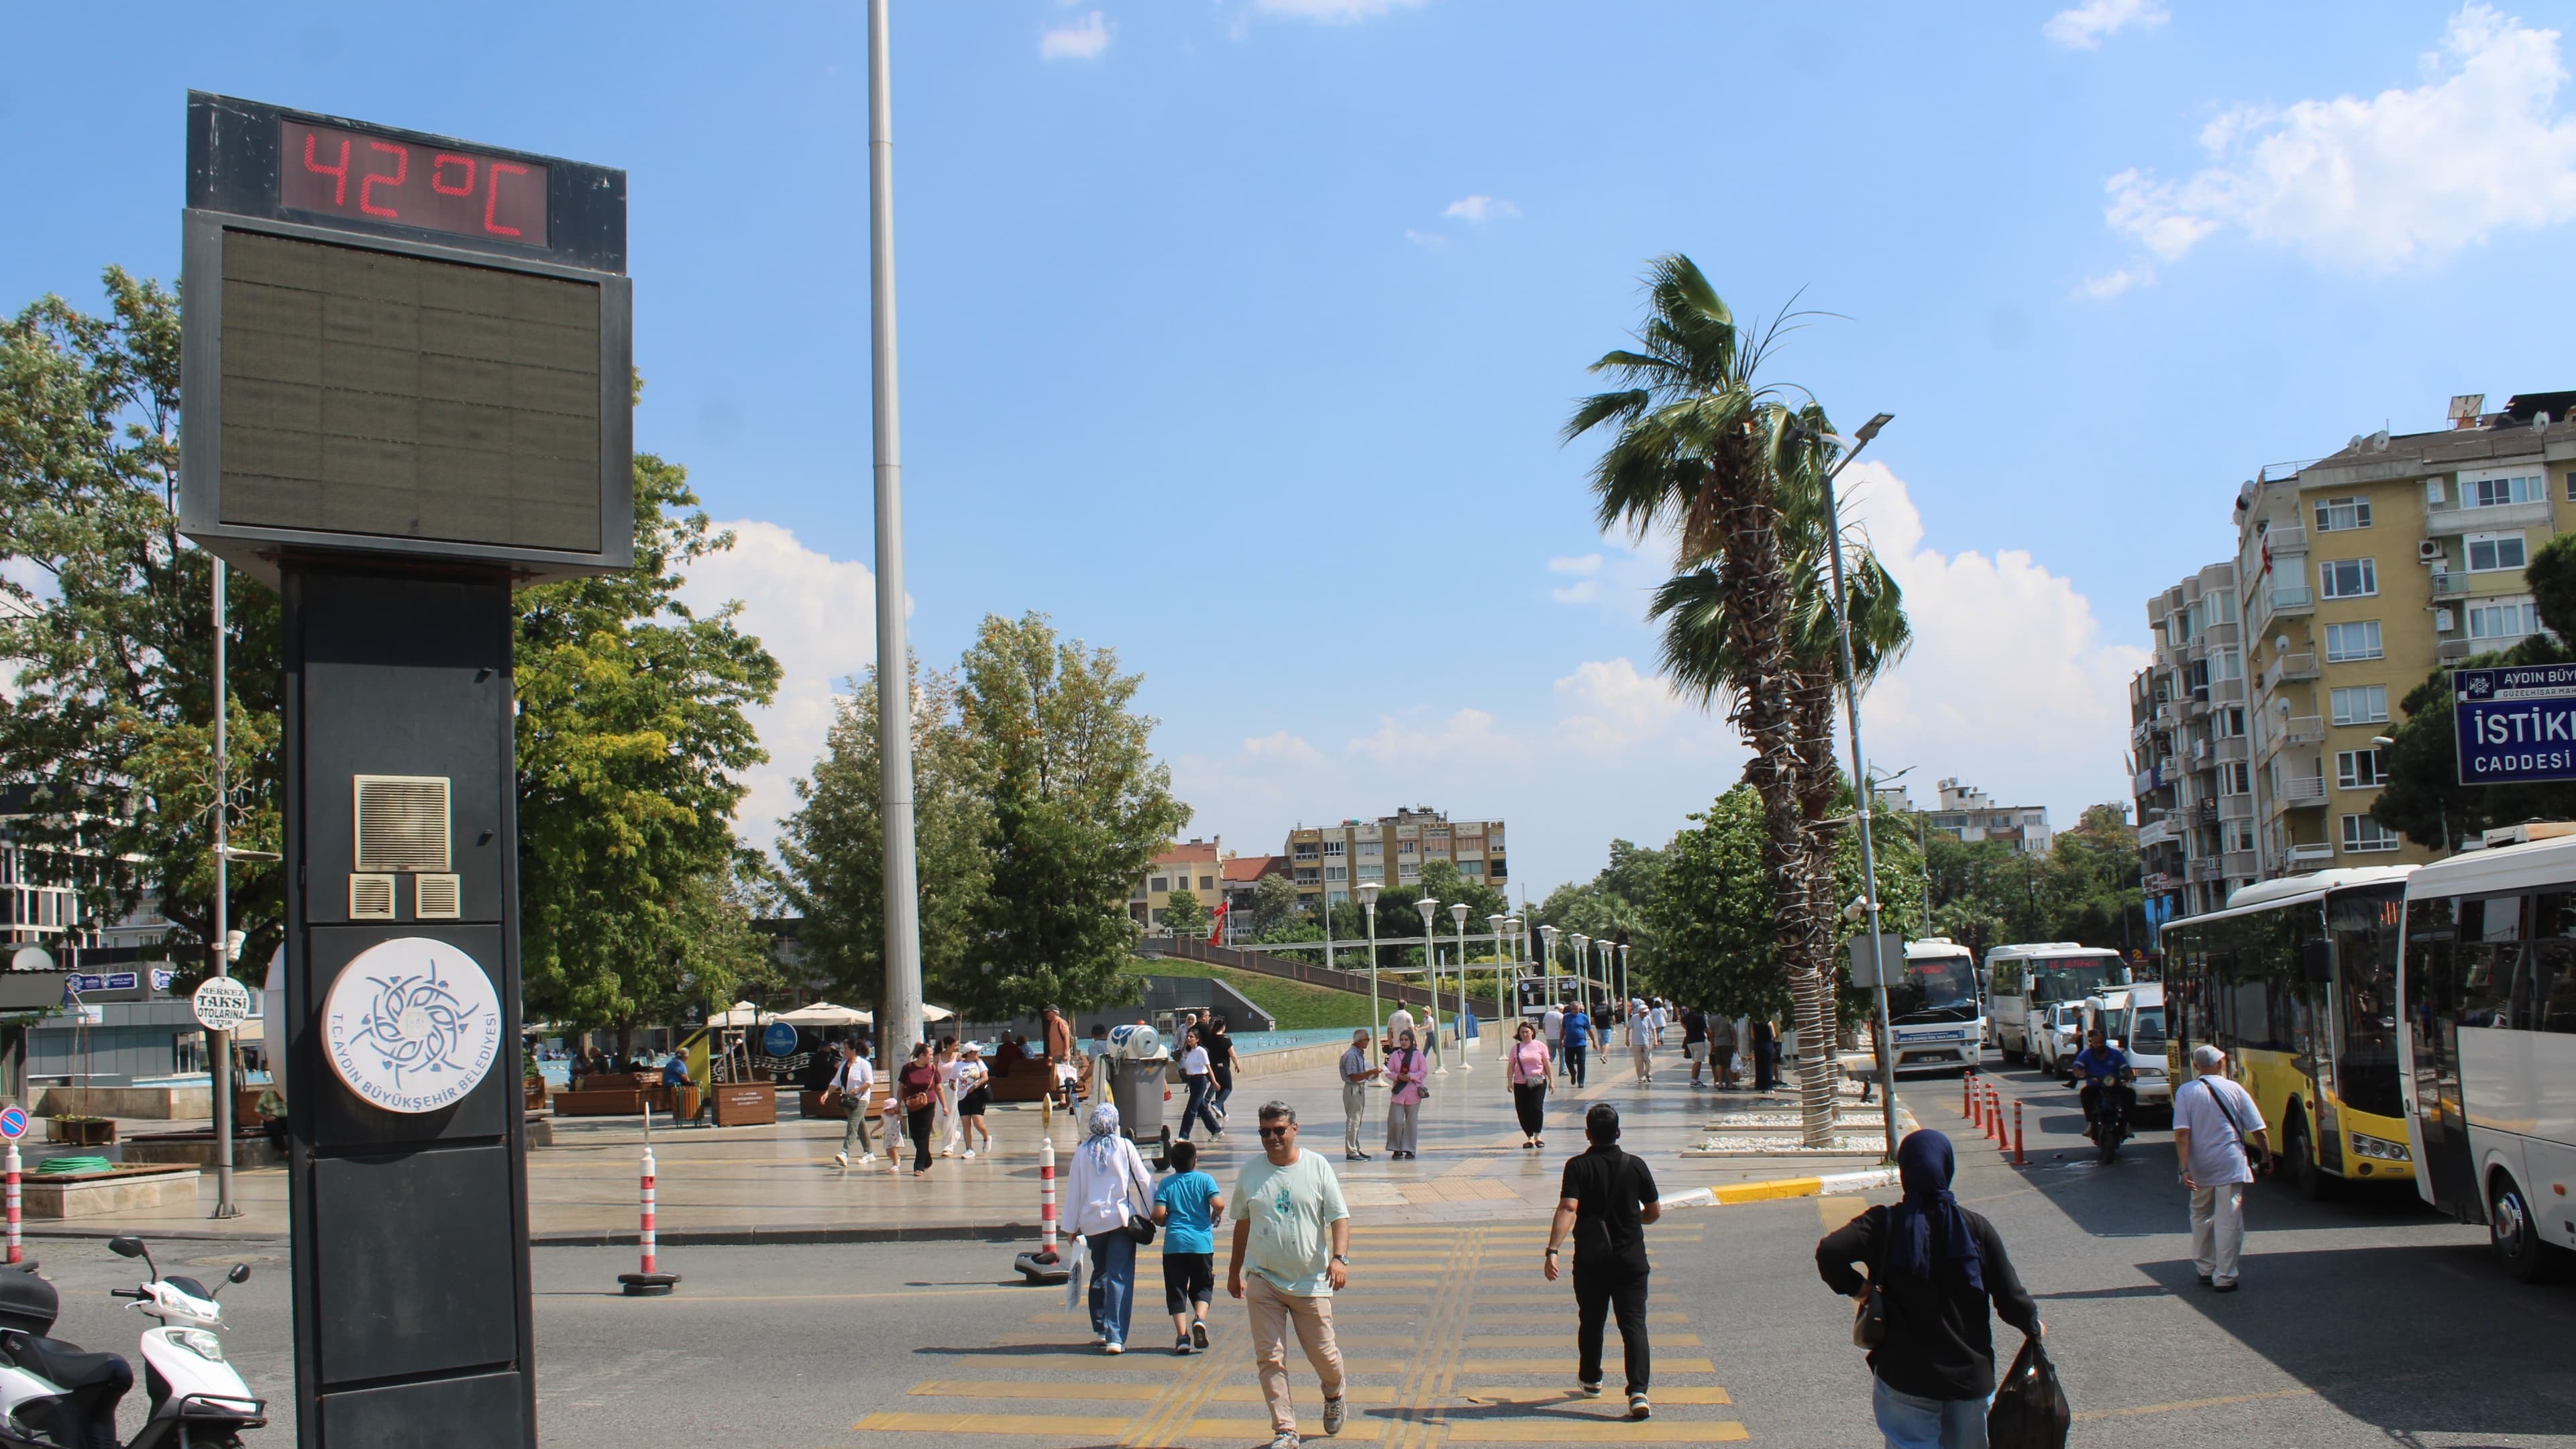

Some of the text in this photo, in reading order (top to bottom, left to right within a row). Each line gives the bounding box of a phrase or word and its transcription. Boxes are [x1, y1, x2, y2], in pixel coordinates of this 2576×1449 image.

[2504, 668, 2576, 685] AYDIN BÜY
[2475, 749, 2571, 772] CADDESİ
[202, 987, 246, 996] MERKEZ
[197, 1008, 244, 1019] OTOLARINA
[334, 1041, 362, 1083] AYDIN
[362, 1081, 458, 1111] BÜYÜKŞEHİR
[458, 1012, 496, 1091] BELEDİYESİ
